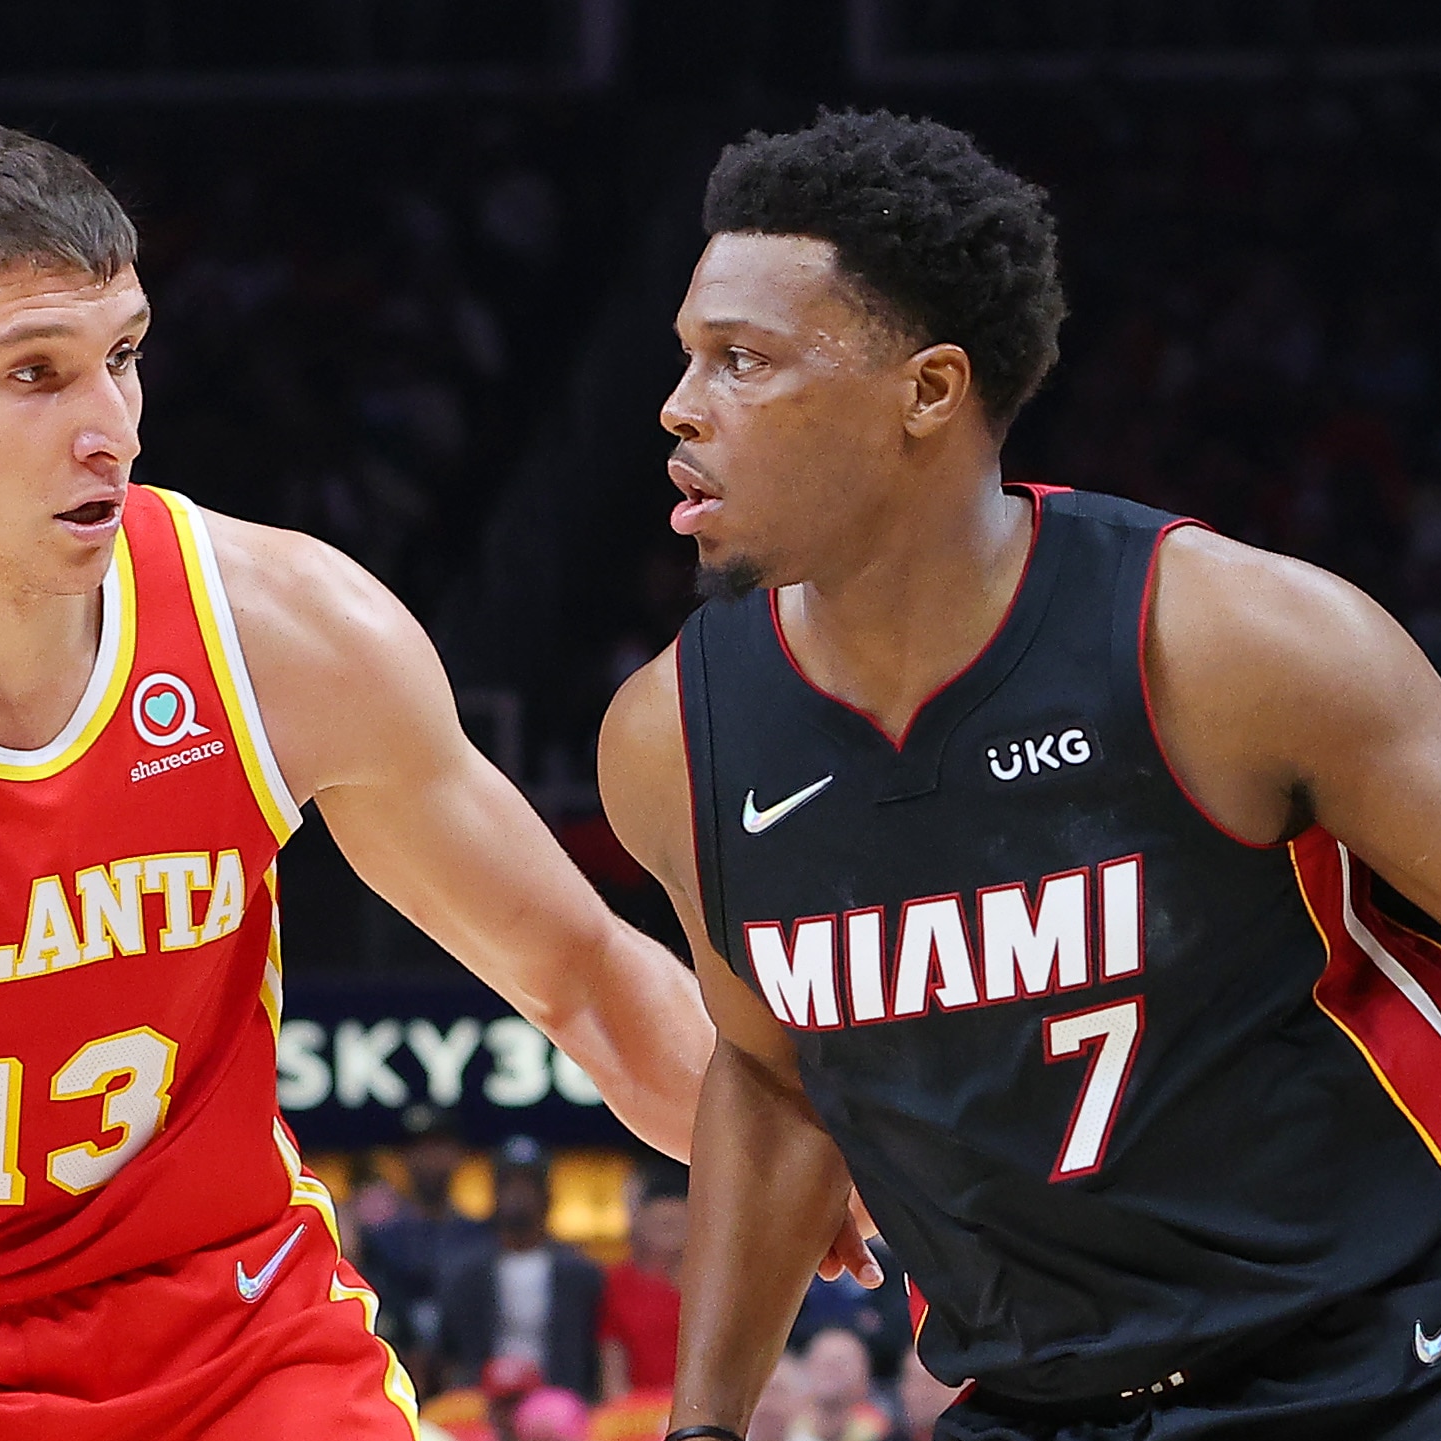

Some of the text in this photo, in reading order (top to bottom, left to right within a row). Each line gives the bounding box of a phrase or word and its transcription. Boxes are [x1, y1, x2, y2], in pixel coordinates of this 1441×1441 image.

[130, 740, 225, 783] sharecare
[742, 851, 1146, 1033] MIAMI
[1041, 994, 1146, 1185] 7
